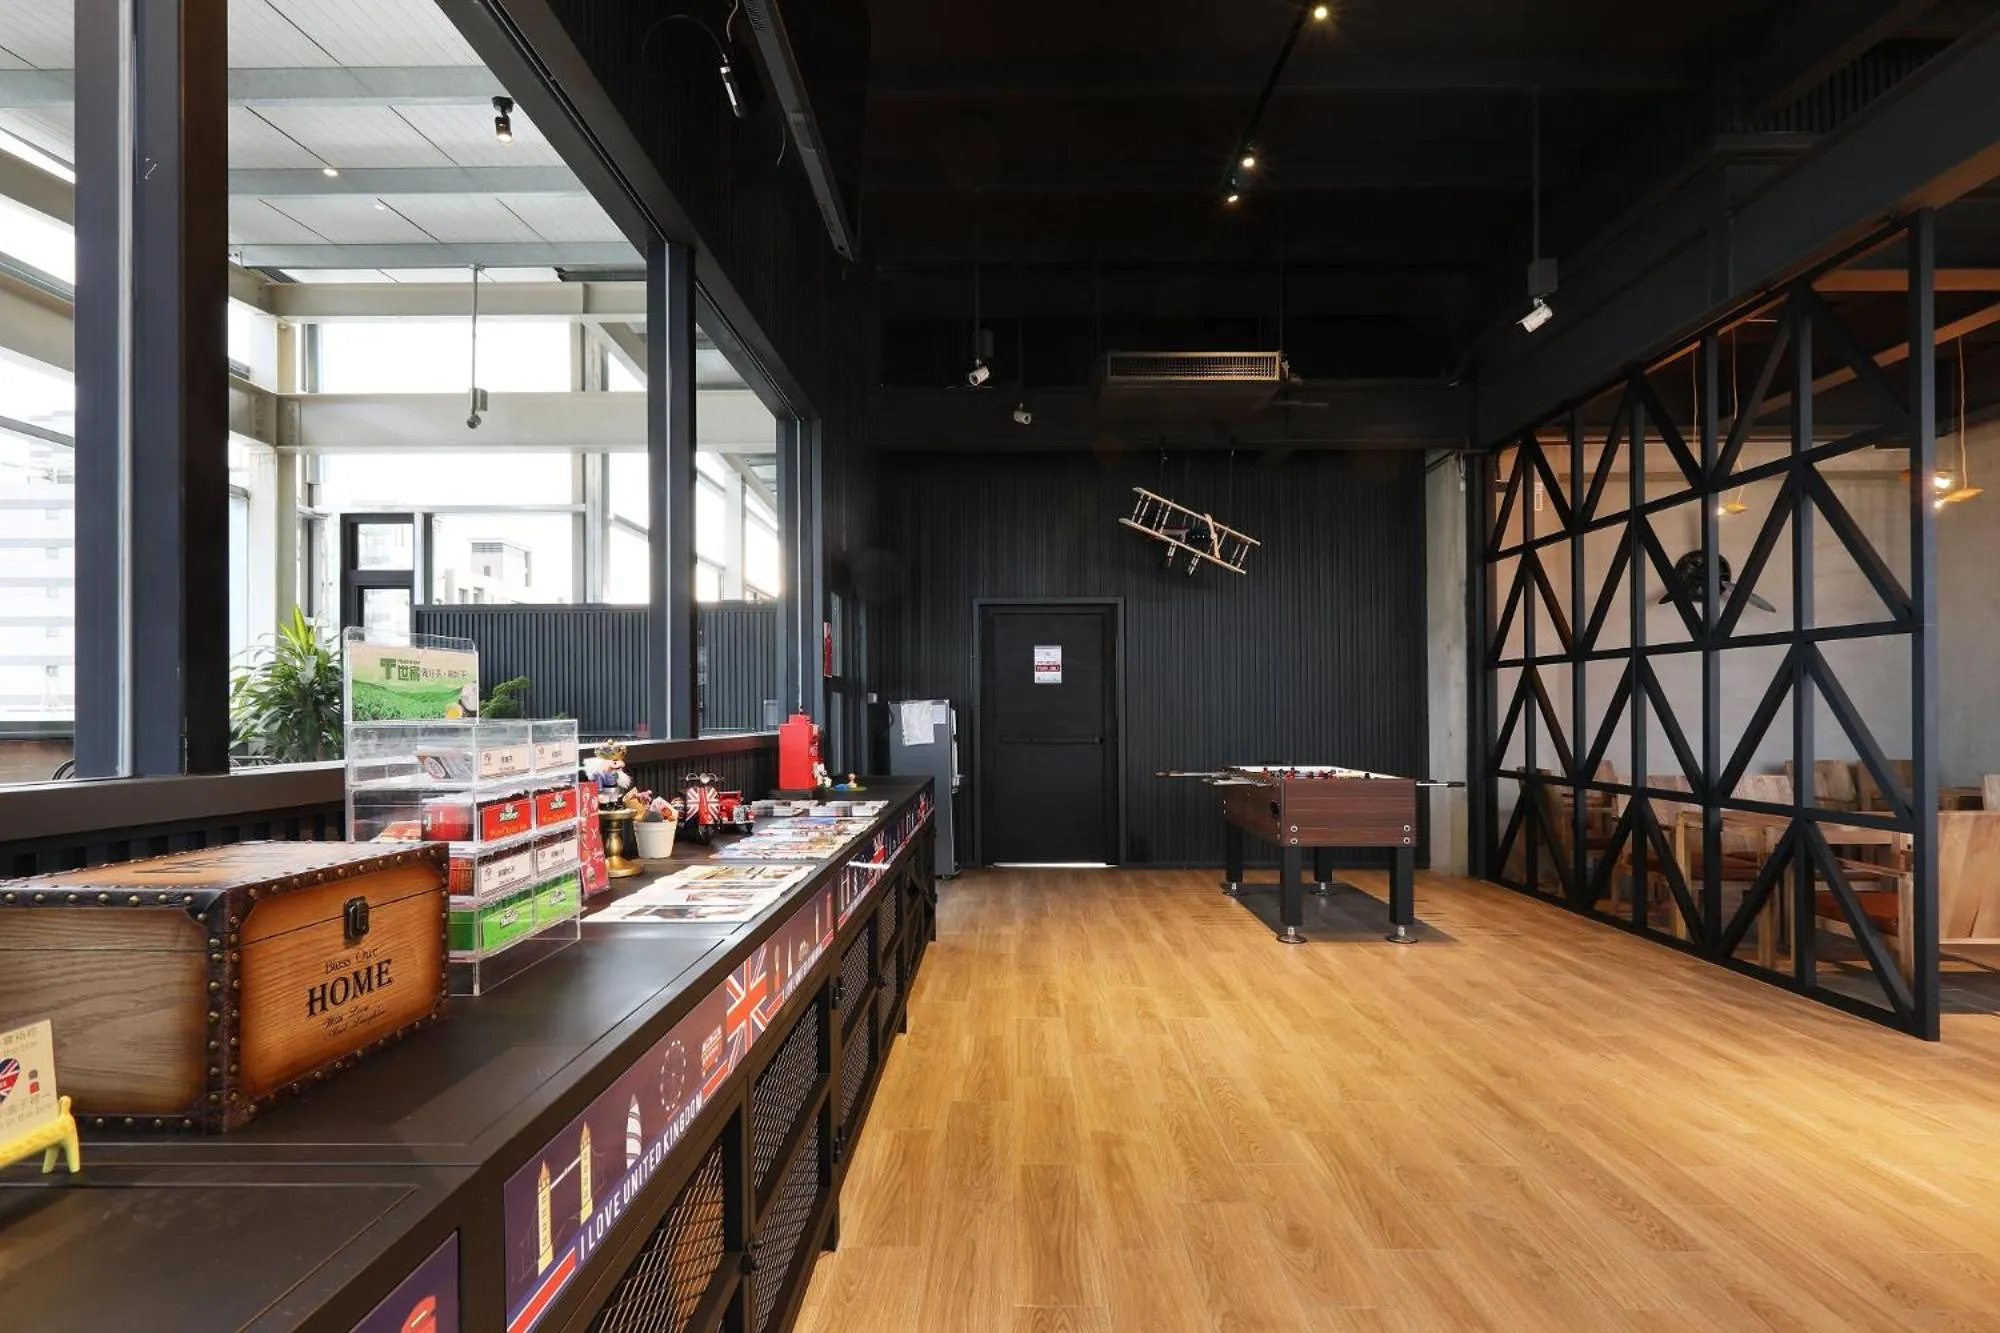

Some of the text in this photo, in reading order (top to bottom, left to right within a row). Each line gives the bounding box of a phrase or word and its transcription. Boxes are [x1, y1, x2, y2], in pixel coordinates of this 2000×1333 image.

[307, 958, 393, 1017] HOME
[580, 1089, 703, 1261] I LOVE UNITED KINGDOM
